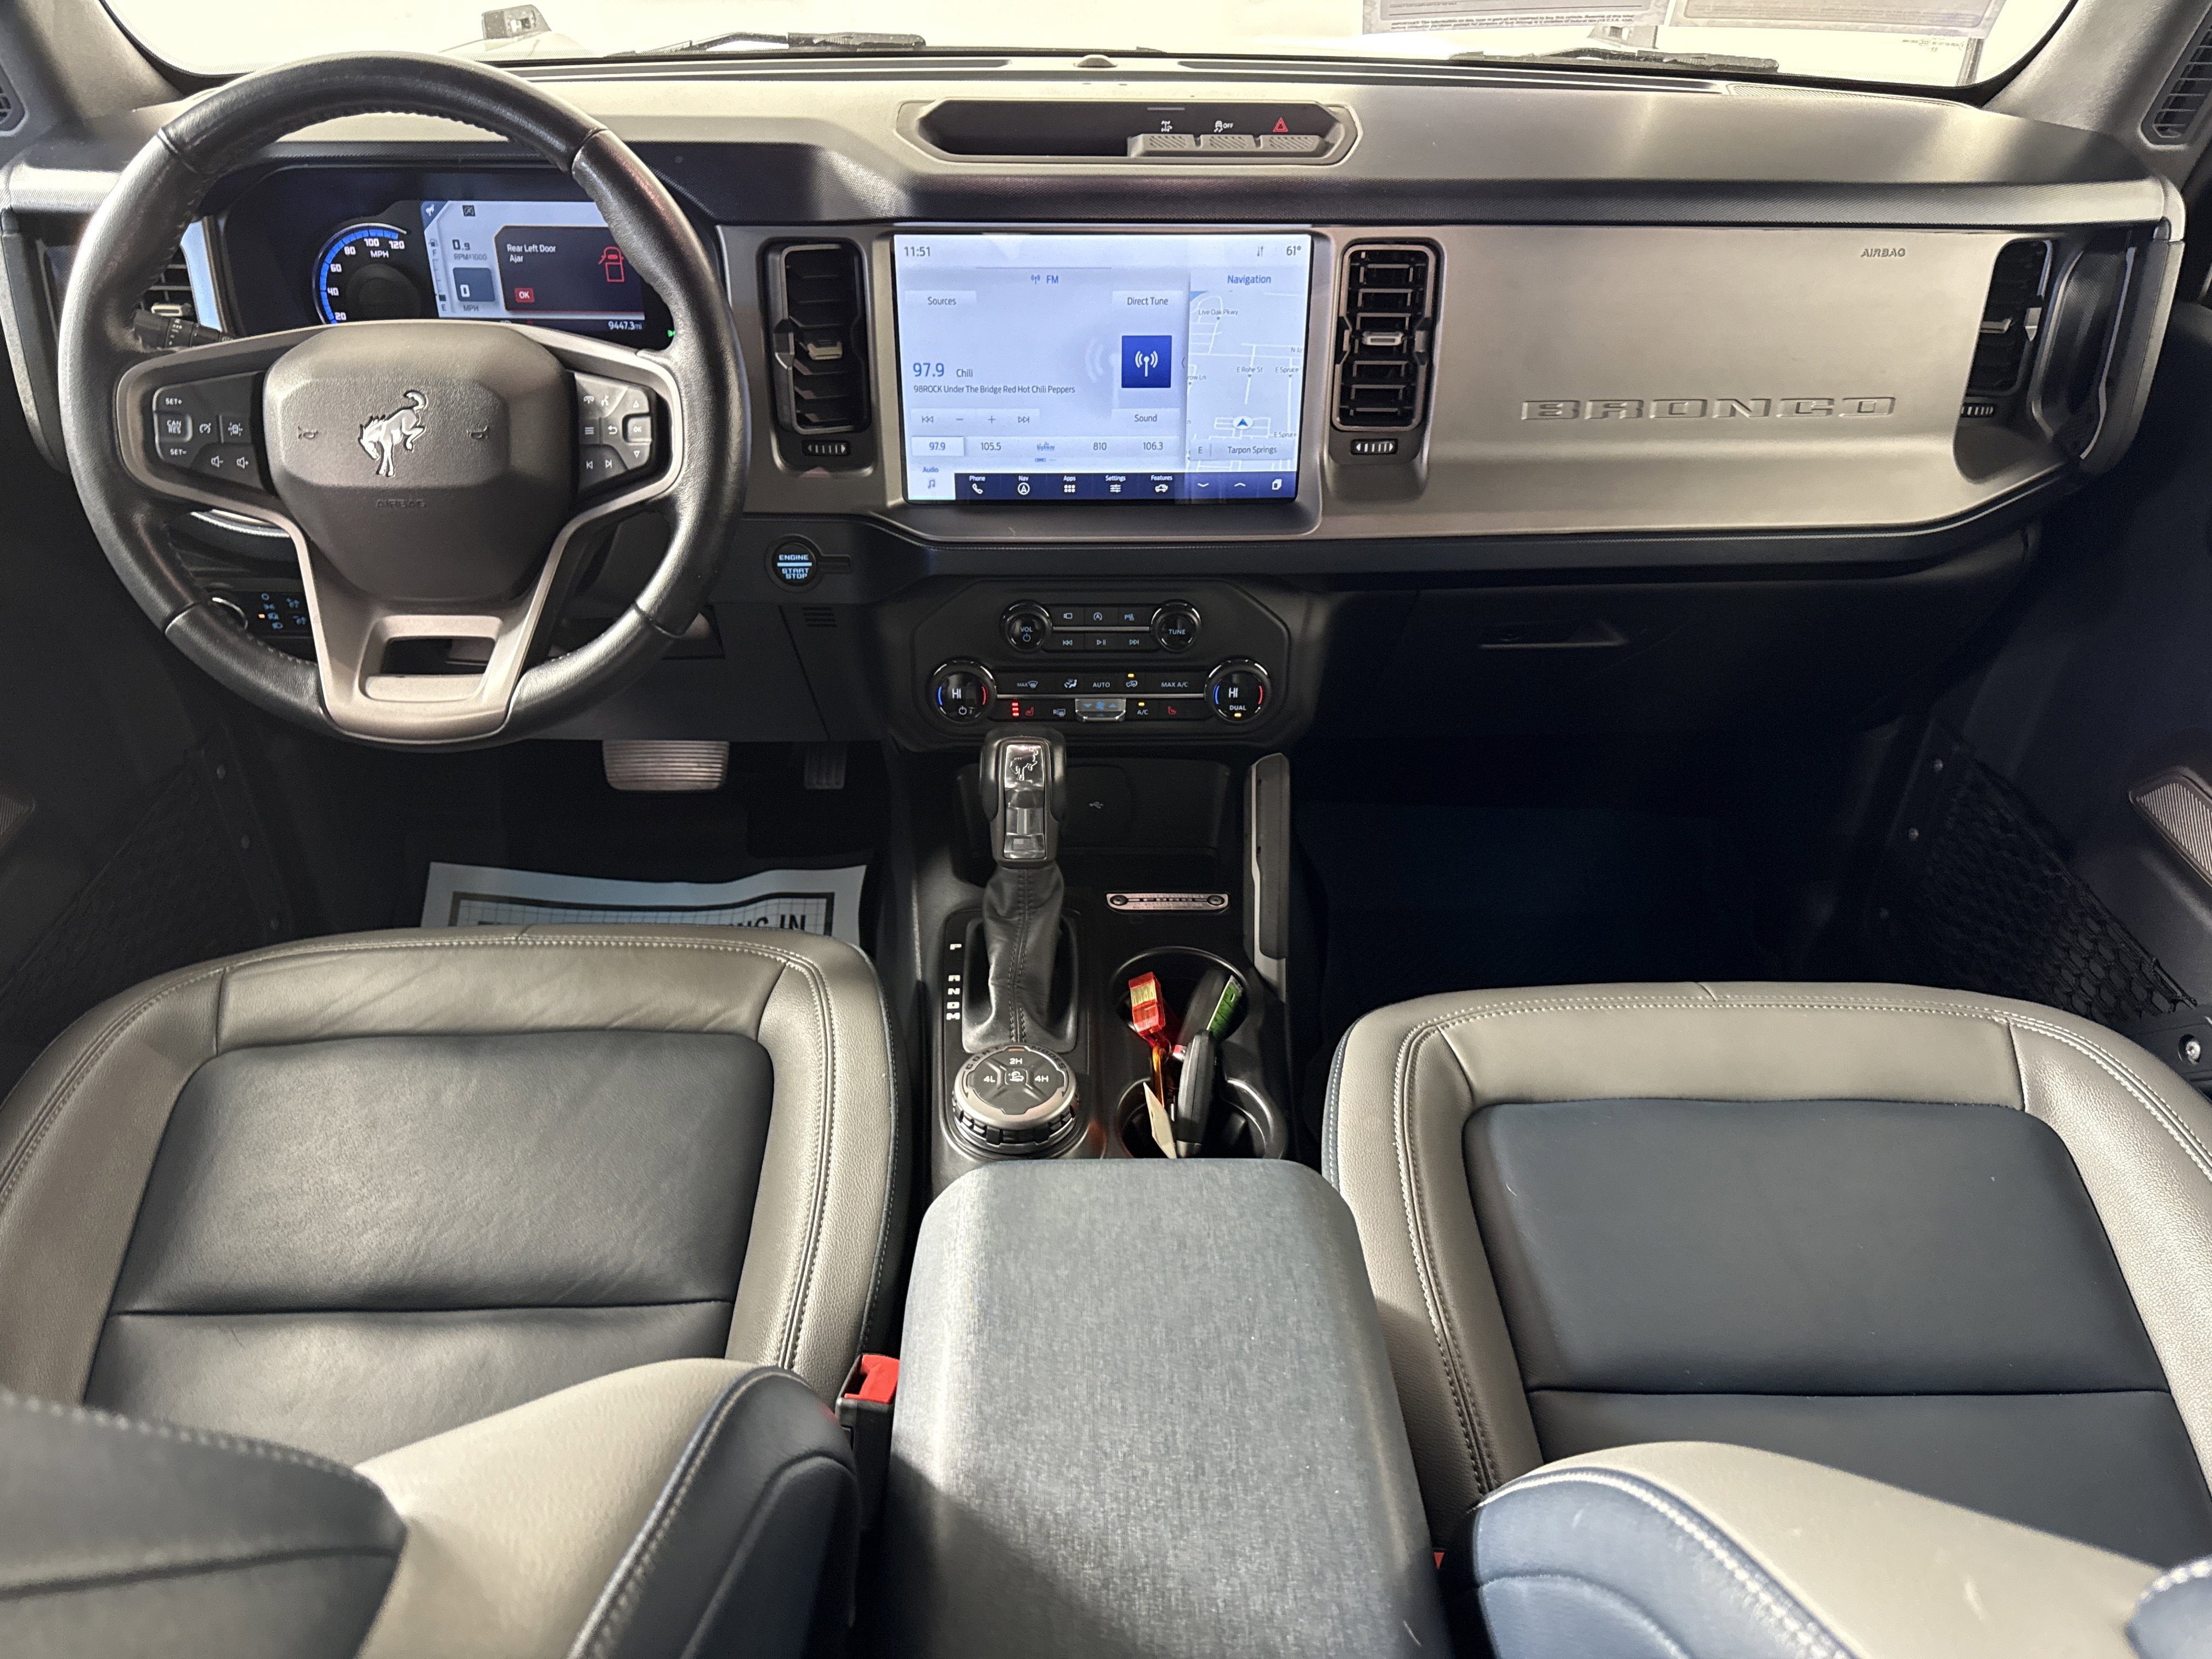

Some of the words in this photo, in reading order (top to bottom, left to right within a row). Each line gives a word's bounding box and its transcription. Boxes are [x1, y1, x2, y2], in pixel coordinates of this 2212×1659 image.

[364, 238, 379, 247] 100
[389, 241, 405, 249] 120
[452, 239, 470, 251] 0.9
[344, 246, 356, 255] 80
[507, 244, 523, 252] Rear
[524, 244, 538, 252] Left
[539, 244, 556, 252] Door
[904, 247, 930, 257] 11:51
[1286, 246, 1301, 256] 61°
[1861, 248, 1906, 257] AIRBAG
[510, 254, 523, 263] Ajar
[330, 264, 342, 272] 60
[1046, 275, 1059, 284] FM
[1227, 275, 1271, 285] Navigation
[328, 287, 339, 296] 40
[460, 284, 470, 297] 0
[928, 297, 956, 306] Sources
[1127, 297, 1148, 305] Direct
[1150, 297, 1168, 305] Tune
[334, 312, 346, 320] 20
[913, 363, 945, 377] 97.9
[956, 369, 973, 377] Chili
[913, 385, 942, 393] 98ROCK
[944, 385, 964, 393] Under
[966, 385, 979, 393] The
[980, 385, 1002, 395] Bridge
[1003, 385, 1016, 393] Red
[1018, 385, 1030, 393] Hot
[1031, 385, 1046, 393] Chili
[1048, 385, 1075, 394] Peppers
[1521, 397, 1896, 420] BRONCO
[1134, 414, 1157, 422] Sound
[929, 442, 946, 450] 97.9
[980, 442, 1001, 450] 105.5
[1093, 442, 1107, 450] 810
[1143, 442, 1163, 450] 106.3
[1228, 446, 1251, 455] Tarpon
[1252, 446, 1277, 455] Springs
[375, 498, 426, 507] AIRBAG
[952, 688, 962, 699] HI
[1228, 687, 1238, 698] HI
[946, 1012, 960, 1020] M
[1031, 1045, 1066, 1069] MODES
